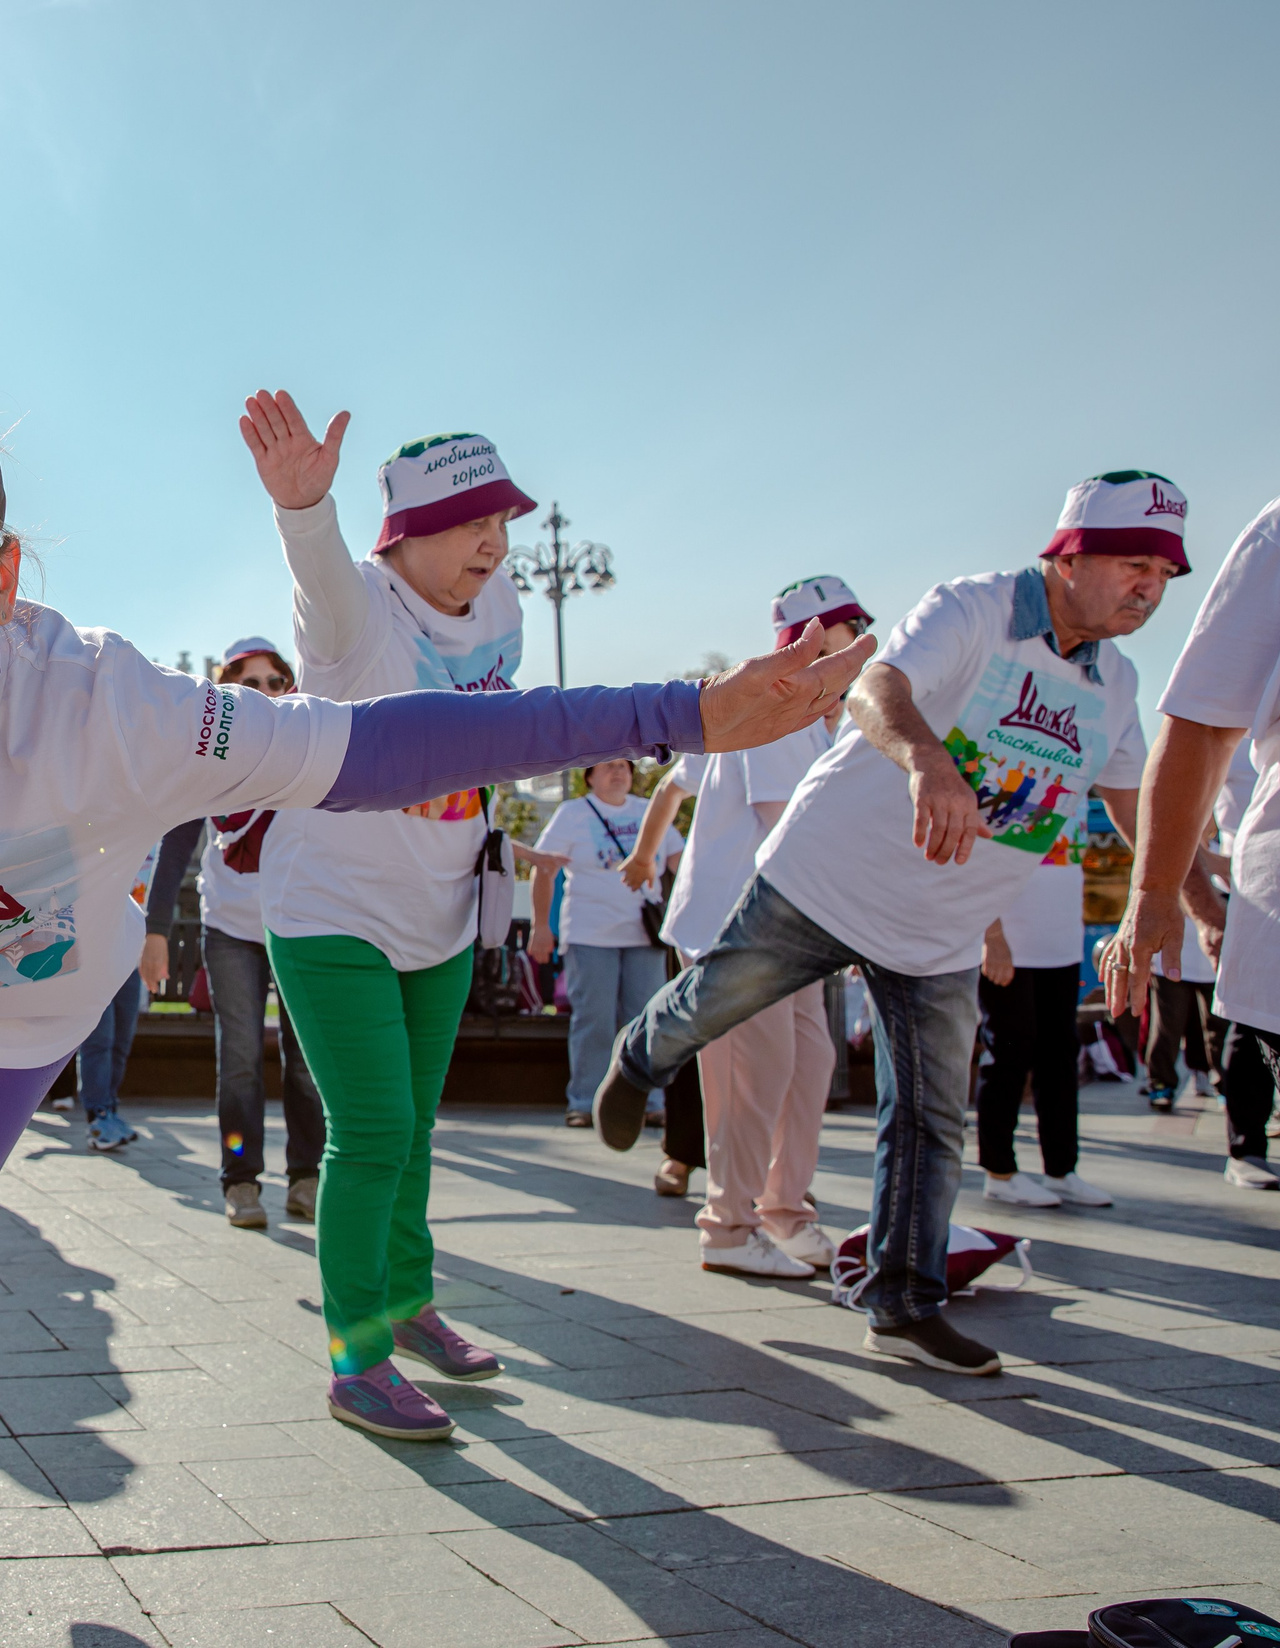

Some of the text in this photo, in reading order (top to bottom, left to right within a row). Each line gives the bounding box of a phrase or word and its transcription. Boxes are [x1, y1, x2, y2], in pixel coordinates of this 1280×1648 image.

[424, 445, 496, 475] любимы
[452, 458, 495, 487] город
[1144, 482, 1187, 519] Моск
[195, 682, 217, 757] МОСКОВ
[213, 686, 235, 760] ДОЛГОЛЕ
[987, 729, 1083, 768] счастливая
